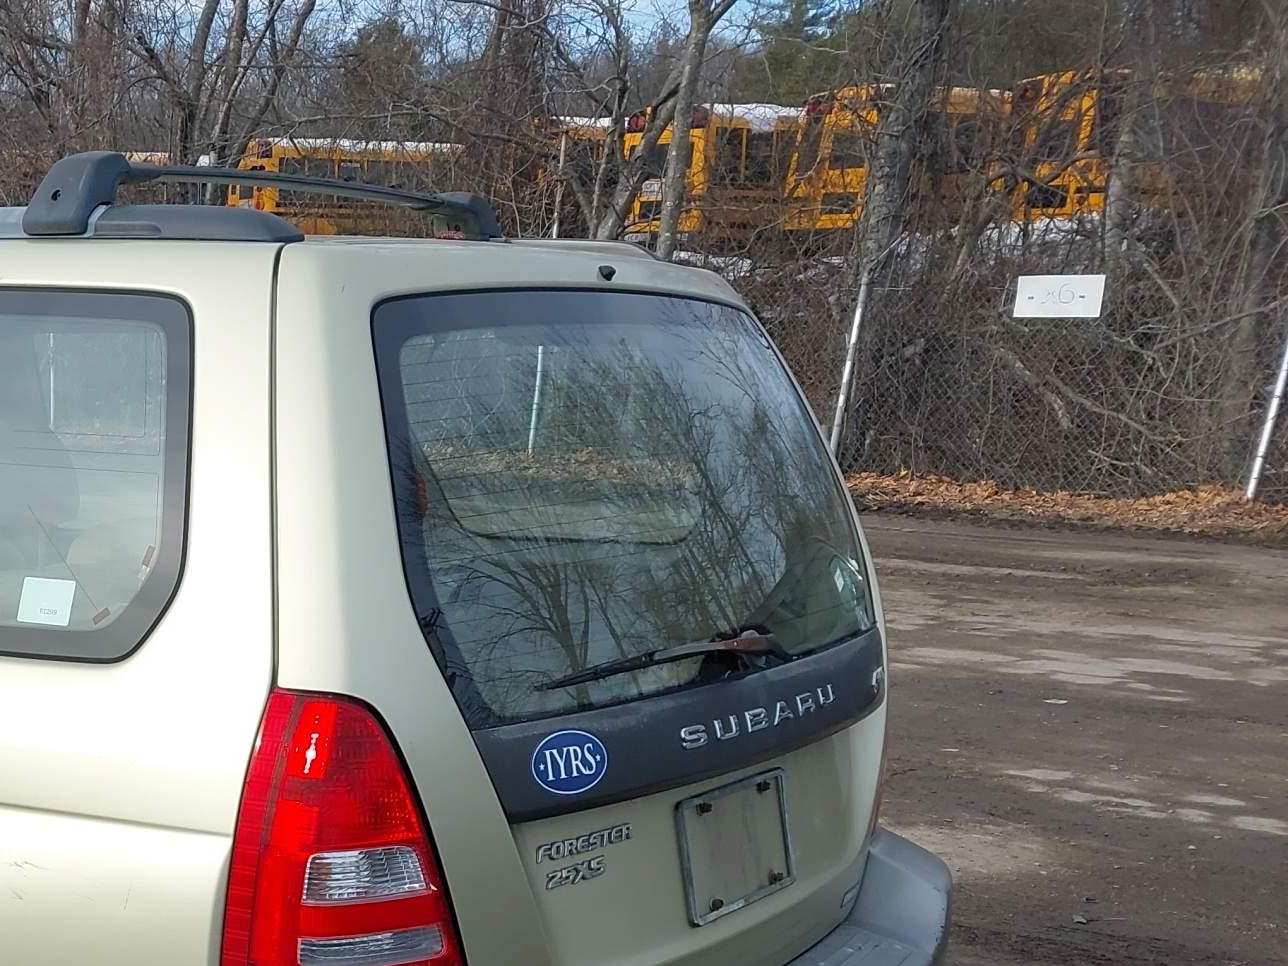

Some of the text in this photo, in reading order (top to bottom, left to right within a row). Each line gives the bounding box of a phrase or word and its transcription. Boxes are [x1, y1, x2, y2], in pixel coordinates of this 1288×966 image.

[680, 682, 837, 750] SUBARU
[543, 742, 598, 781] IYRS
[536, 823, 633, 864] FORESTER
